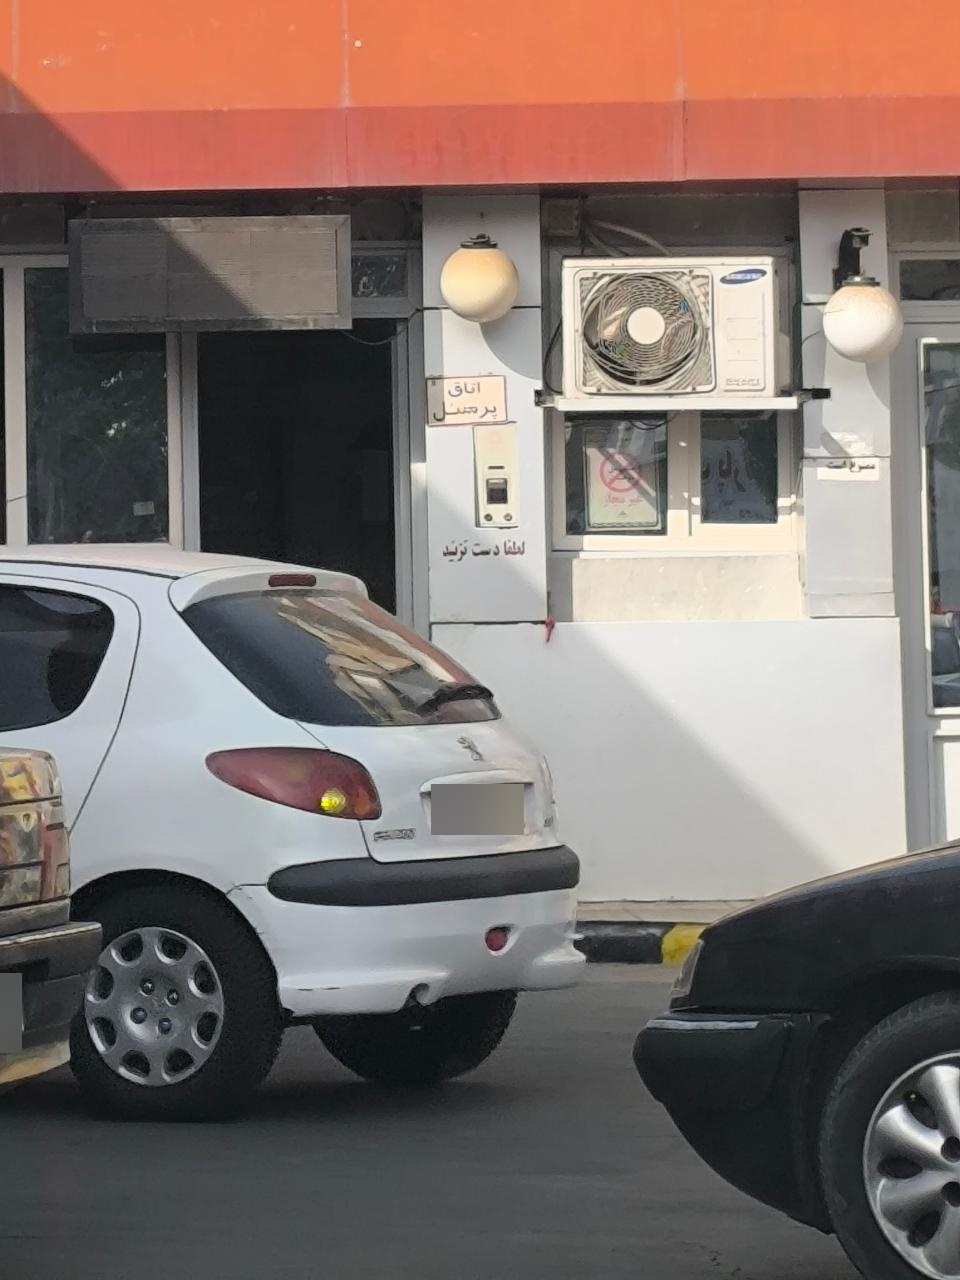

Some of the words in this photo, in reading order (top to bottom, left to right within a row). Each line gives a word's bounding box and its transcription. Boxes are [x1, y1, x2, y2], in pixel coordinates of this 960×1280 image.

[448, 381, 481, 397] اتاق
[433, 400, 498, 422] پرسنل
[442, 539, 468, 562] نزنید
[471, 542, 500, 556] دست
